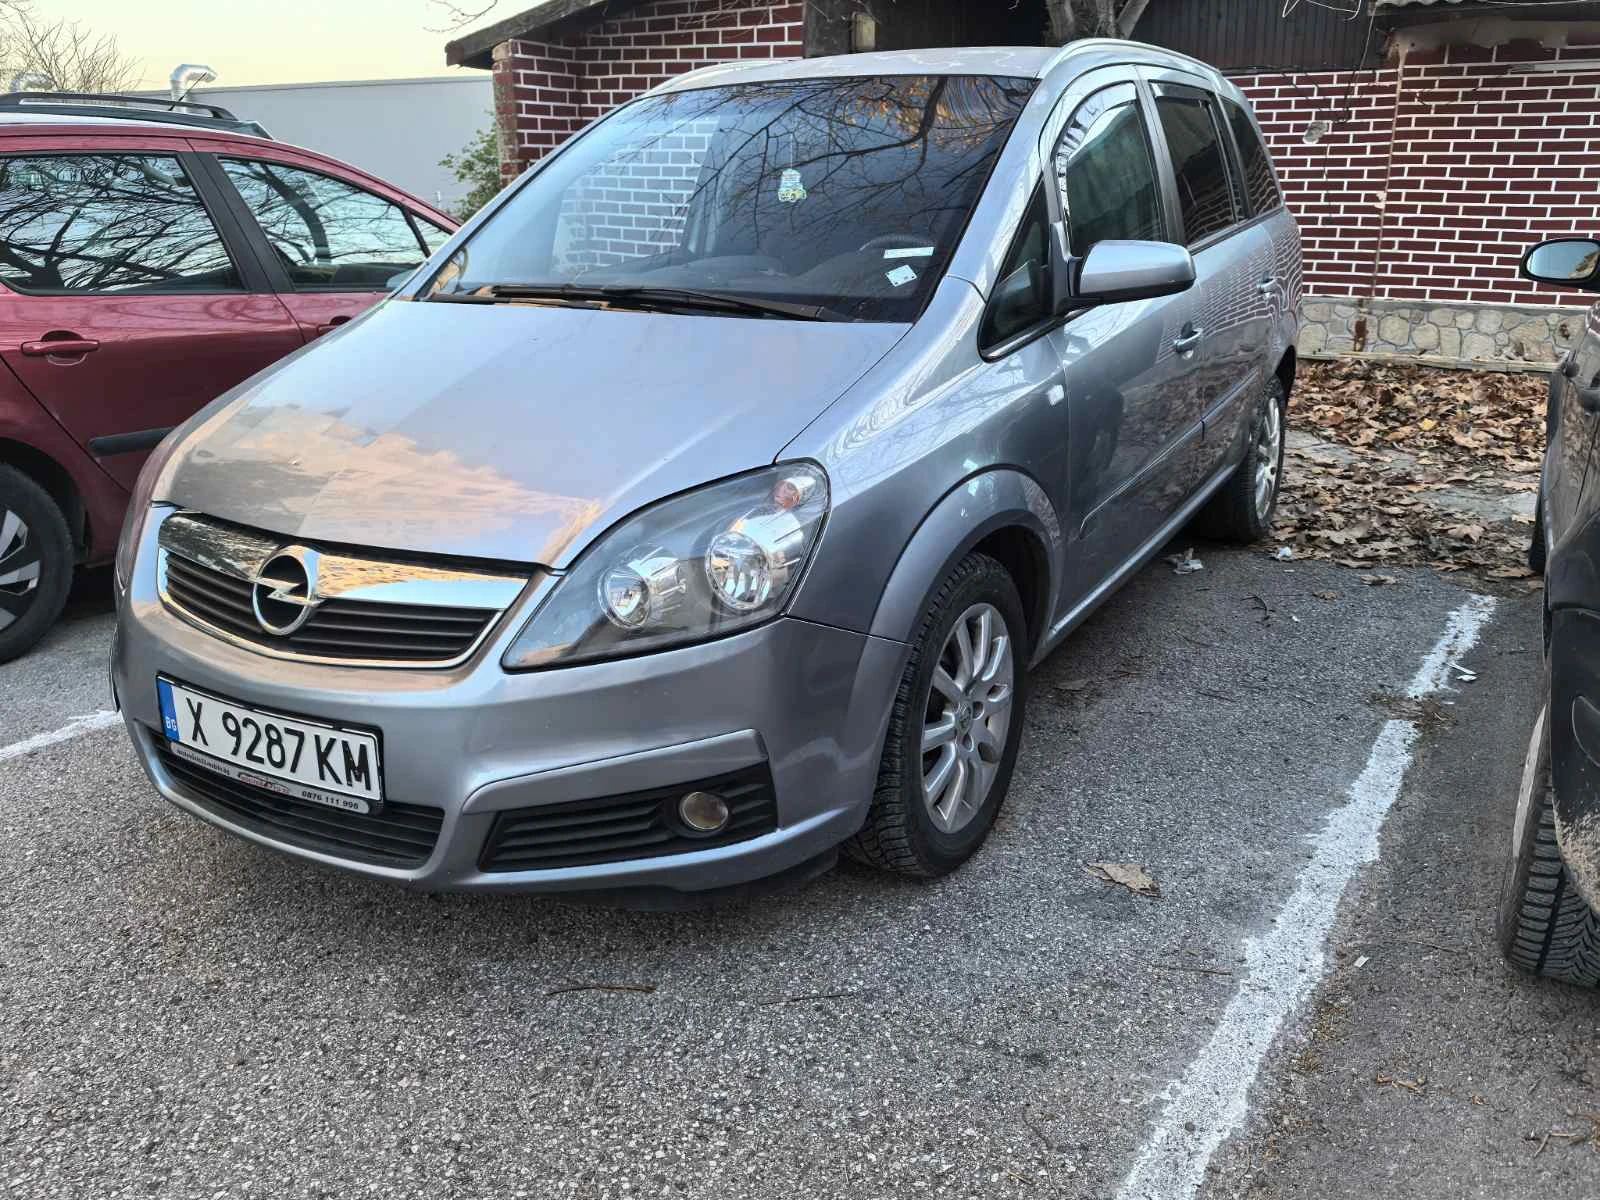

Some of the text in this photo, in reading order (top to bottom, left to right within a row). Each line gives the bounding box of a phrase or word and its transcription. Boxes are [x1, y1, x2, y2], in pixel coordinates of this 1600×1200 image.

[186, 697, 209, 747] X
[221, 711, 305, 774] 9287
[314, 734, 372, 792] KM
[326, 796, 339, 805] 111
